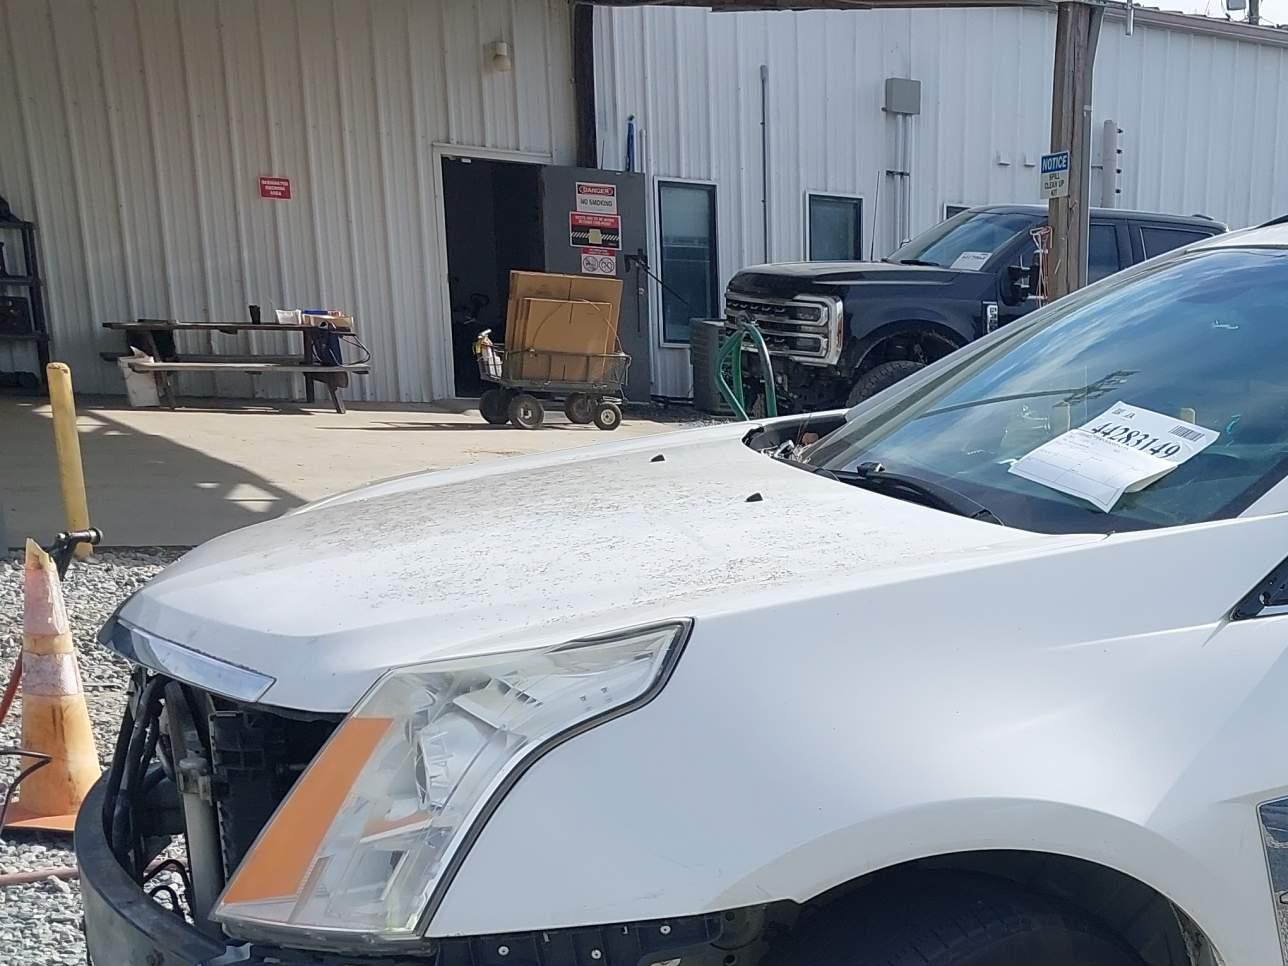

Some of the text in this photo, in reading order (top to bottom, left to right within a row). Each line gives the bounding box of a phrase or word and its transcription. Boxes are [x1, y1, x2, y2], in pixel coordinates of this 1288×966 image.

[1042, 155, 1067, 171] NOTICE
[1044, 181, 1057, 189] CLEAN
[582, 186, 609, 194] DANGER
[589, 199, 612, 207] SMOKING
[1091, 422, 1181, 459] 44283149
